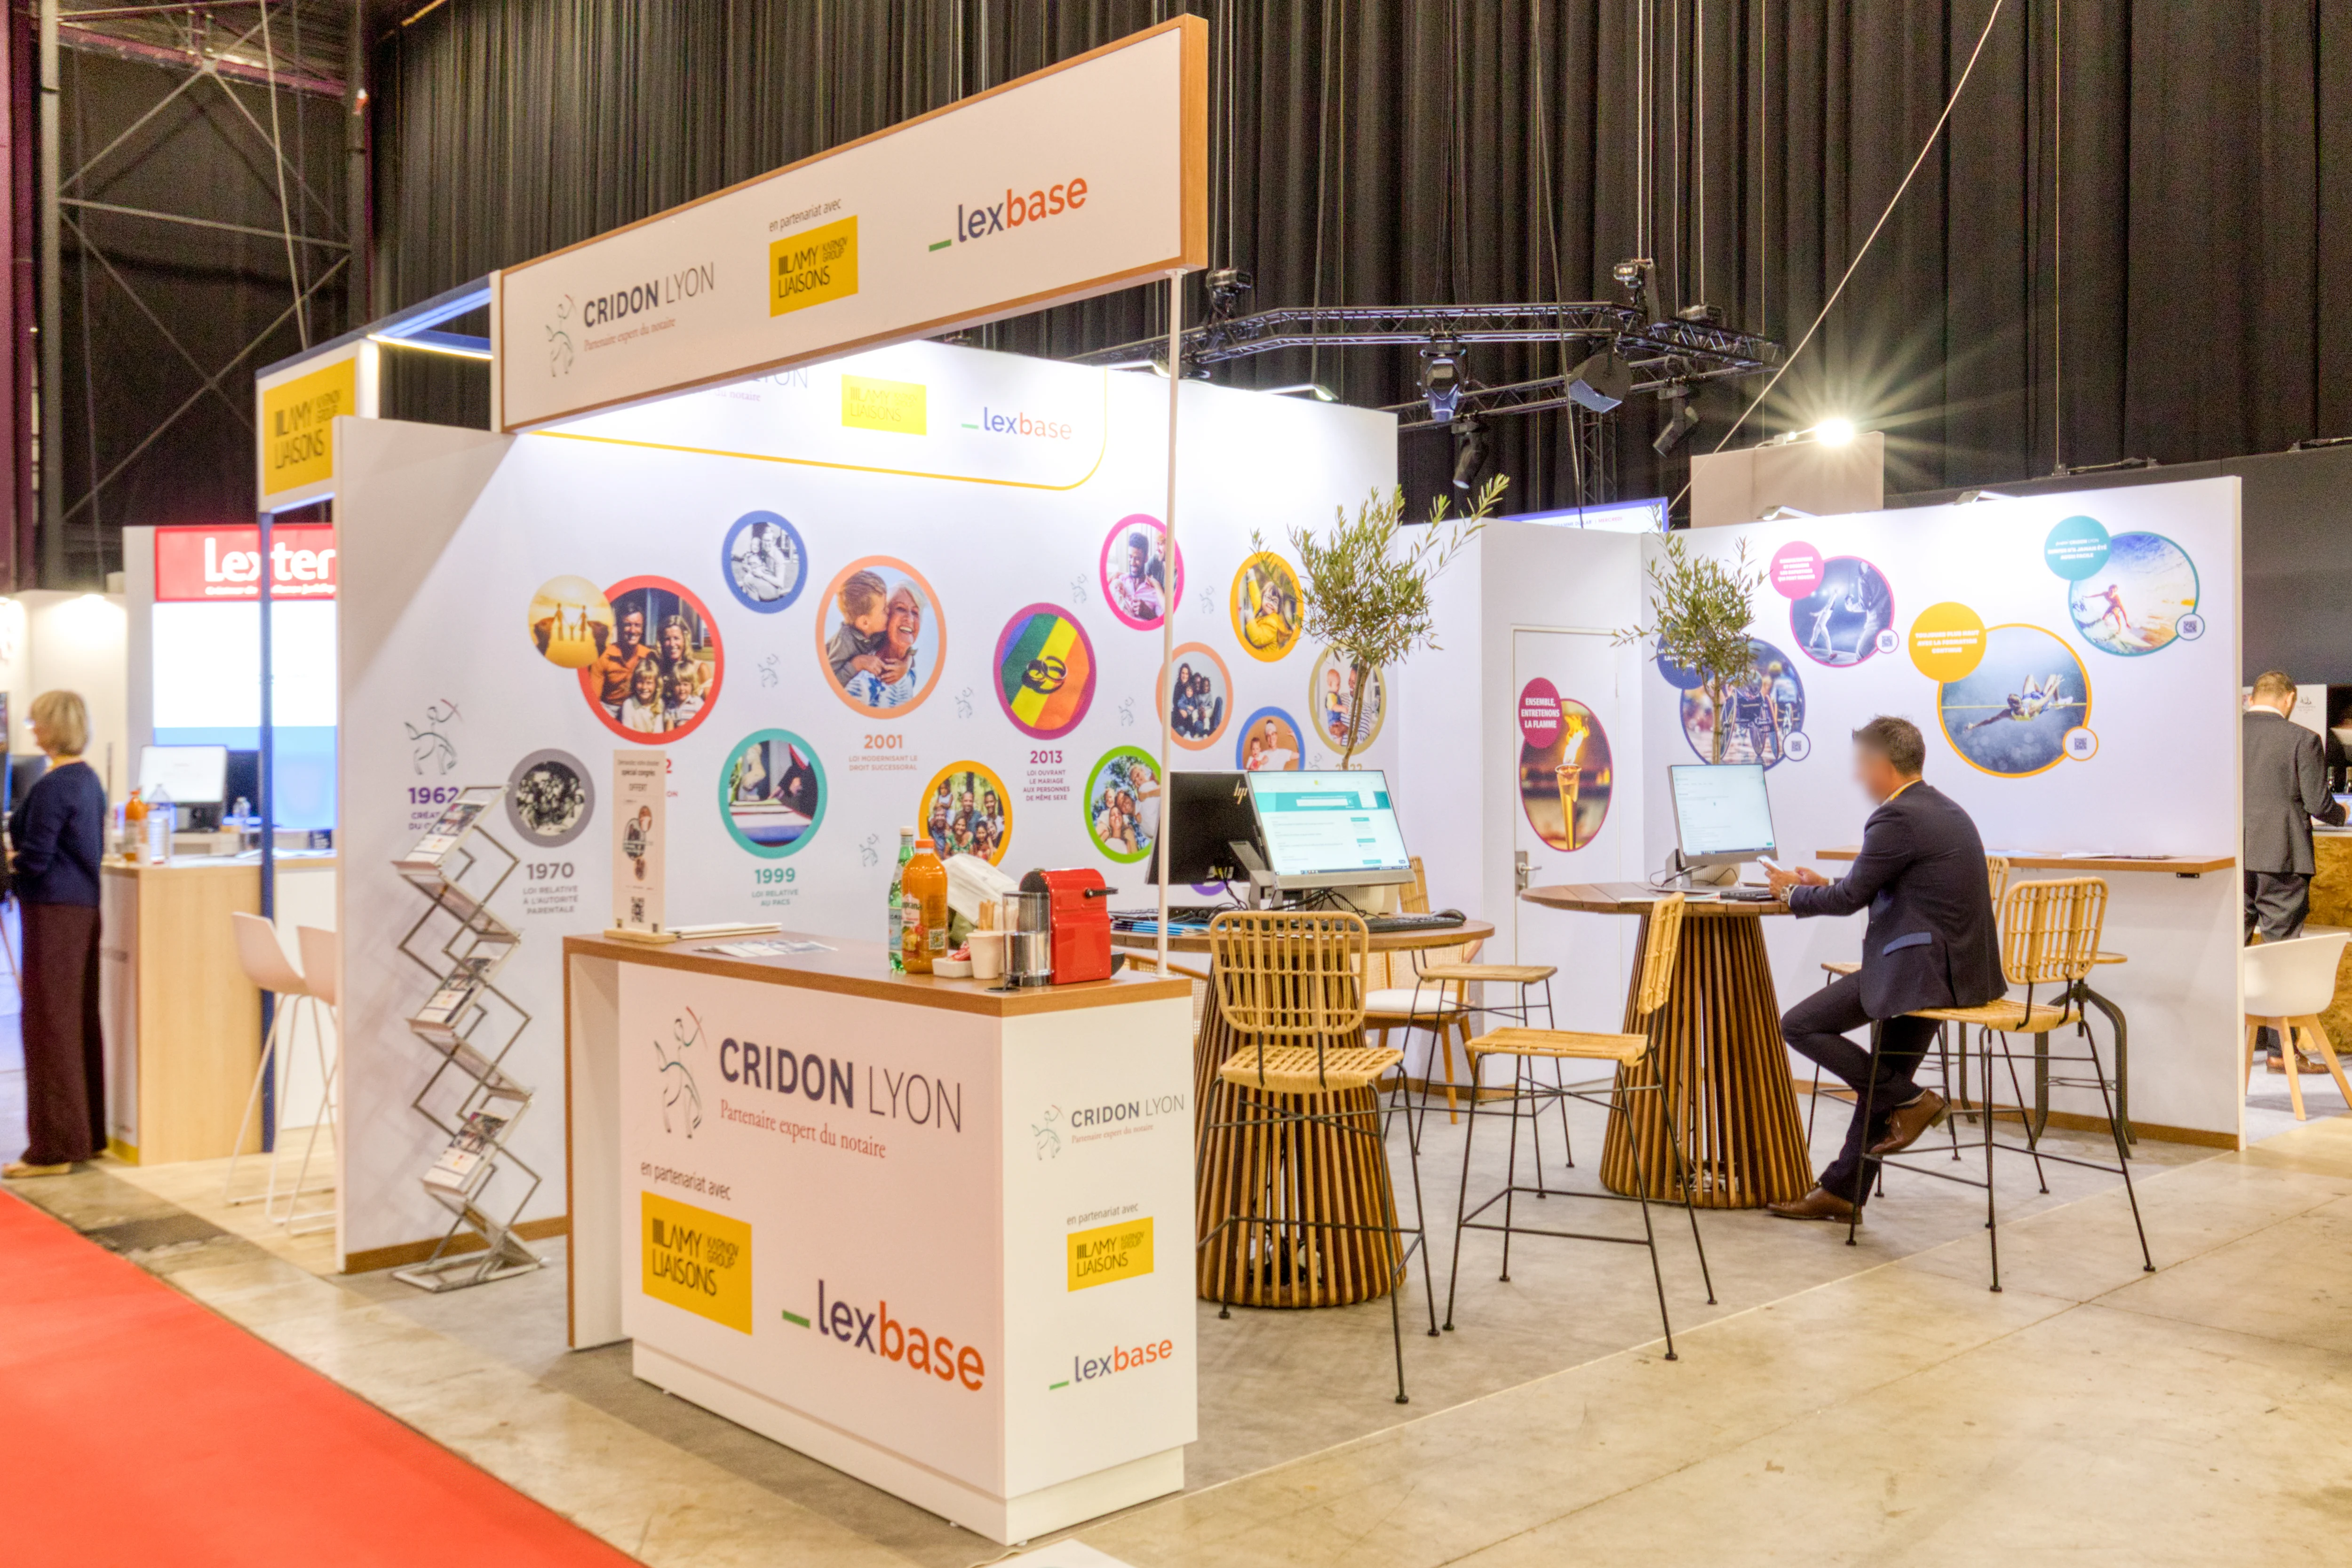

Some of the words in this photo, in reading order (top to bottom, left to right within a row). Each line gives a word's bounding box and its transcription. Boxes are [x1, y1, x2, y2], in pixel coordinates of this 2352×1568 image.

[769, 220, 778, 232] en
[780, 204, 821, 231] partenariat
[823, 199, 841, 213] avec
[958, 177, 1088, 243] lexbase
[786, 245, 819, 274] LAMY
[779, 265, 830, 298] LIAISONS
[584, 279, 659, 327] CRIDON
[666, 262, 714, 304] LYON
[858, 387, 890, 405] LAMY
[850, 403, 901, 422] LIAISONS
[984, 406, 1072, 440] lexbase
[1521, 708, 1560, 717] ENTRETENONS
[1525, 698, 1556, 708] ENSEMBLE,
[1524, 720, 1533, 728] LA
[1533, 720, 1557, 728] FLAMME
[864, 733, 903, 749] 2001
[1030, 749, 1063, 764] 2013
[408, 787, 459, 804] 1962
[526, 862, 575, 880] 1970
[755, 867, 796, 884] 1999
[539, 884, 579, 894] RELATIVE
[526, 905, 575, 915] PARENTALE
[719, 1037, 854, 1109] CRIDON
[868, 1065, 962, 1133] LYON
[1071, 1101, 1140, 1129] CRIDON
[1145, 1094, 1185, 1117] LYON
[720, 1099, 776, 1132] Partenaire
[779, 1121, 817, 1148] expert
[819, 1123, 837, 1146] du
[840, 1132, 886, 1159] notaire
[1071, 1130, 1102, 1145] Partenaire
[1103, 1128, 1122, 1143] expert
[1123, 1126, 1132, 1136] du
[1132, 1122, 1154, 1134] notaire
[641, 1160, 652, 1177] en
[654, 1163, 707, 1194] partenariat
[708, 1179, 731, 1201] avec
[1066, 1215, 1077, 1226] en
[1078, 1205, 1120, 1226] partenariat
[1121, 1202, 1139, 1215] avec
[660, 1219, 703, 1260] LAMY
[1084, 1236, 1118, 1258] LAMY
[1120, 1239, 1142, 1250] GROUP
[707, 1249, 736, 1269] GROUP
[1076, 1250, 1128, 1278] LIAISONS
[652, 1248, 718, 1297] LIAISONS
[818, 1279, 985, 1393] lexbase
[1074, 1338, 1173, 1383] lexbase
